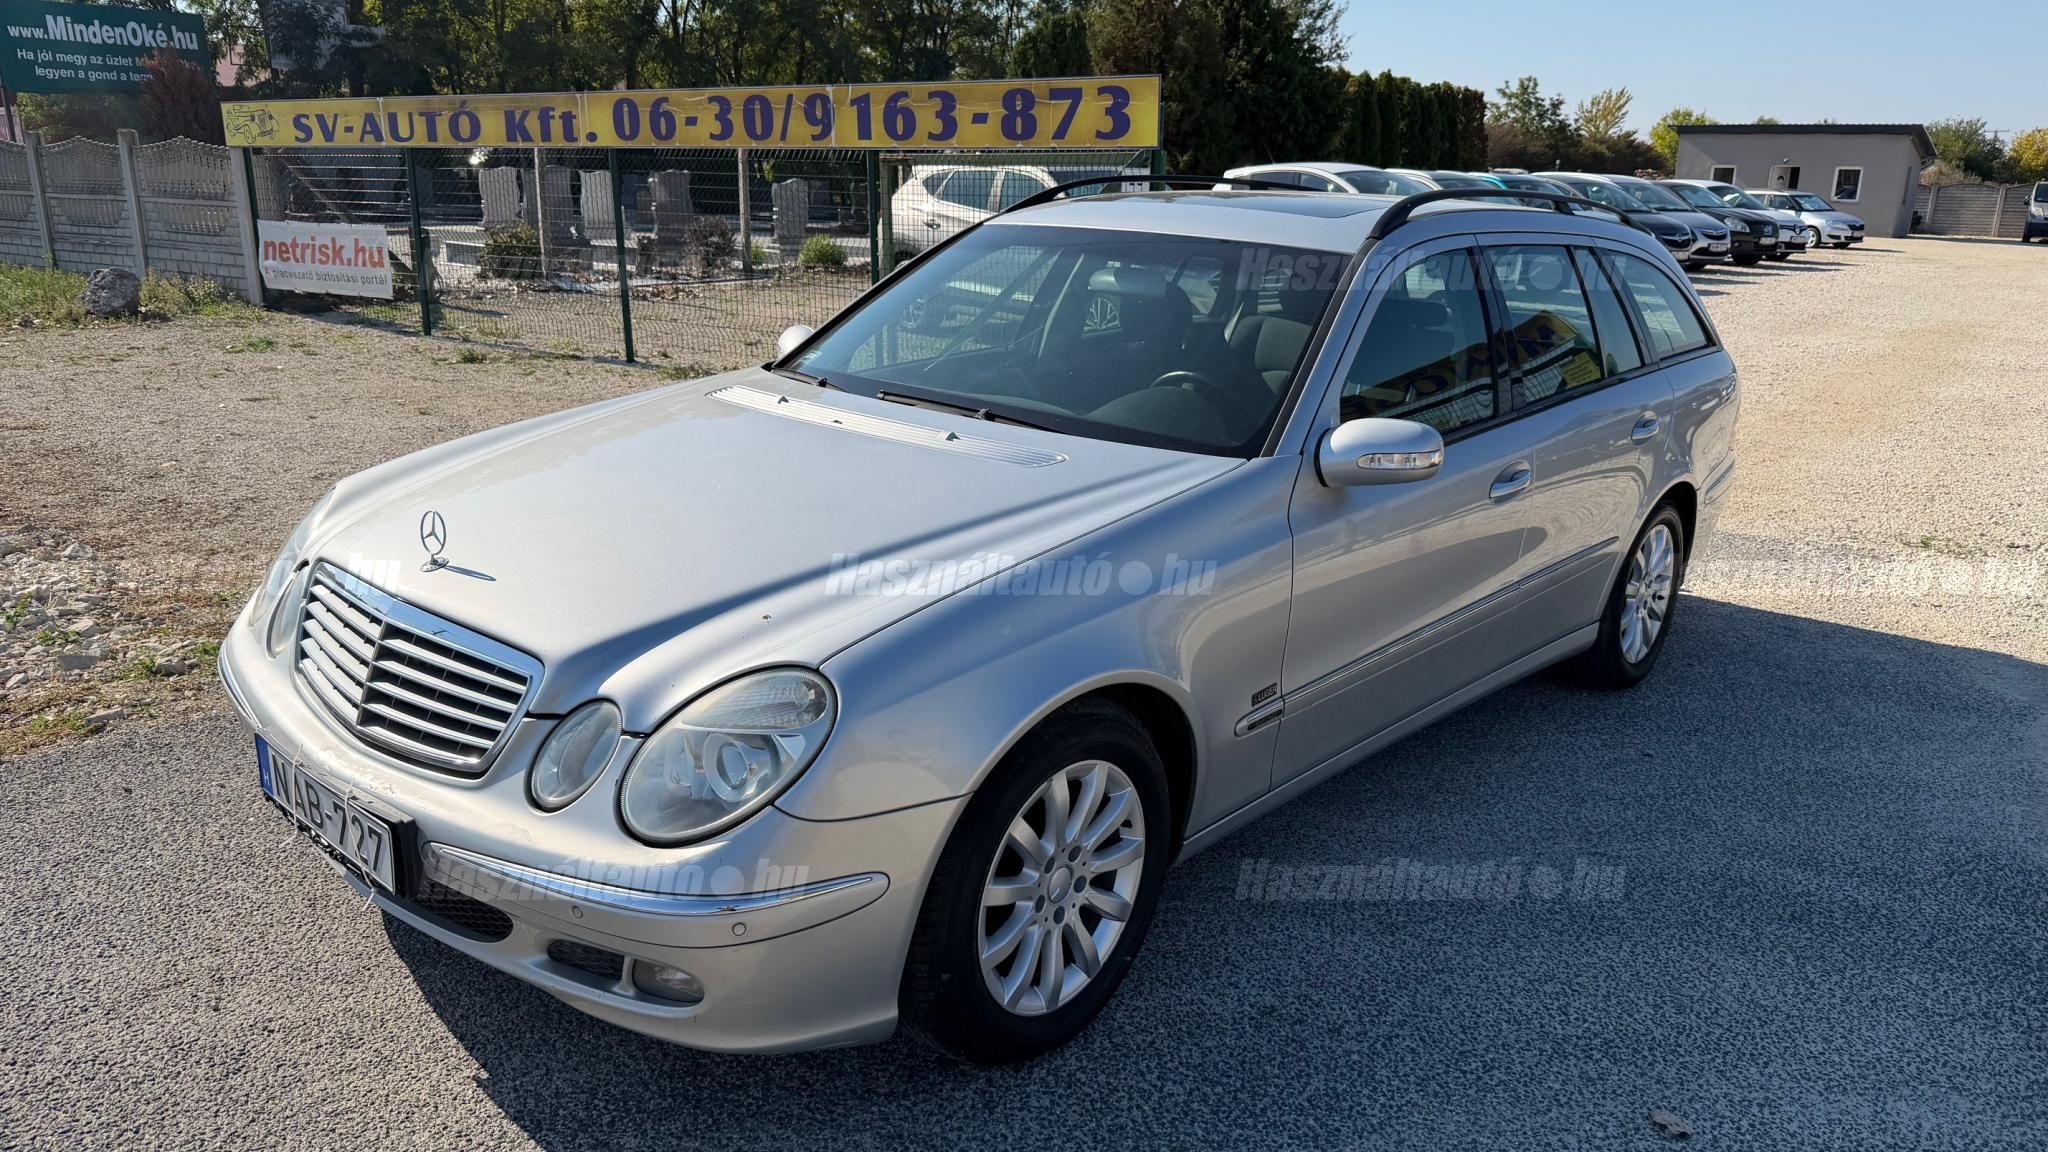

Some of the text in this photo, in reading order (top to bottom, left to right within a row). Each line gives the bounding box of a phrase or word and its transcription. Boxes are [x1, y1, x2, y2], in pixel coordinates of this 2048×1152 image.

[7, 14, 199, 50] www.MindenOké.hu
[17, 48, 34, 60] Ha
[37, 49, 53, 63] jól
[56, 53, 87, 66] megy
[90, 55, 104, 65] az
[106, 54, 133, 66] üzlet
[35, 65, 75, 79] legyen
[78, 70, 85, 79] a
[88, 69, 118, 82] gond
[120, 72, 127, 81] a
[292, 84, 1132, 144] SV-AUTÓ Kft. 06-30/9163-873
[263, 235, 386, 269] netrisk.hu
[316, 271, 359, 284] biztosítási
[361, 274, 388, 286] portál
[271, 753, 385, 873] NAB-727
